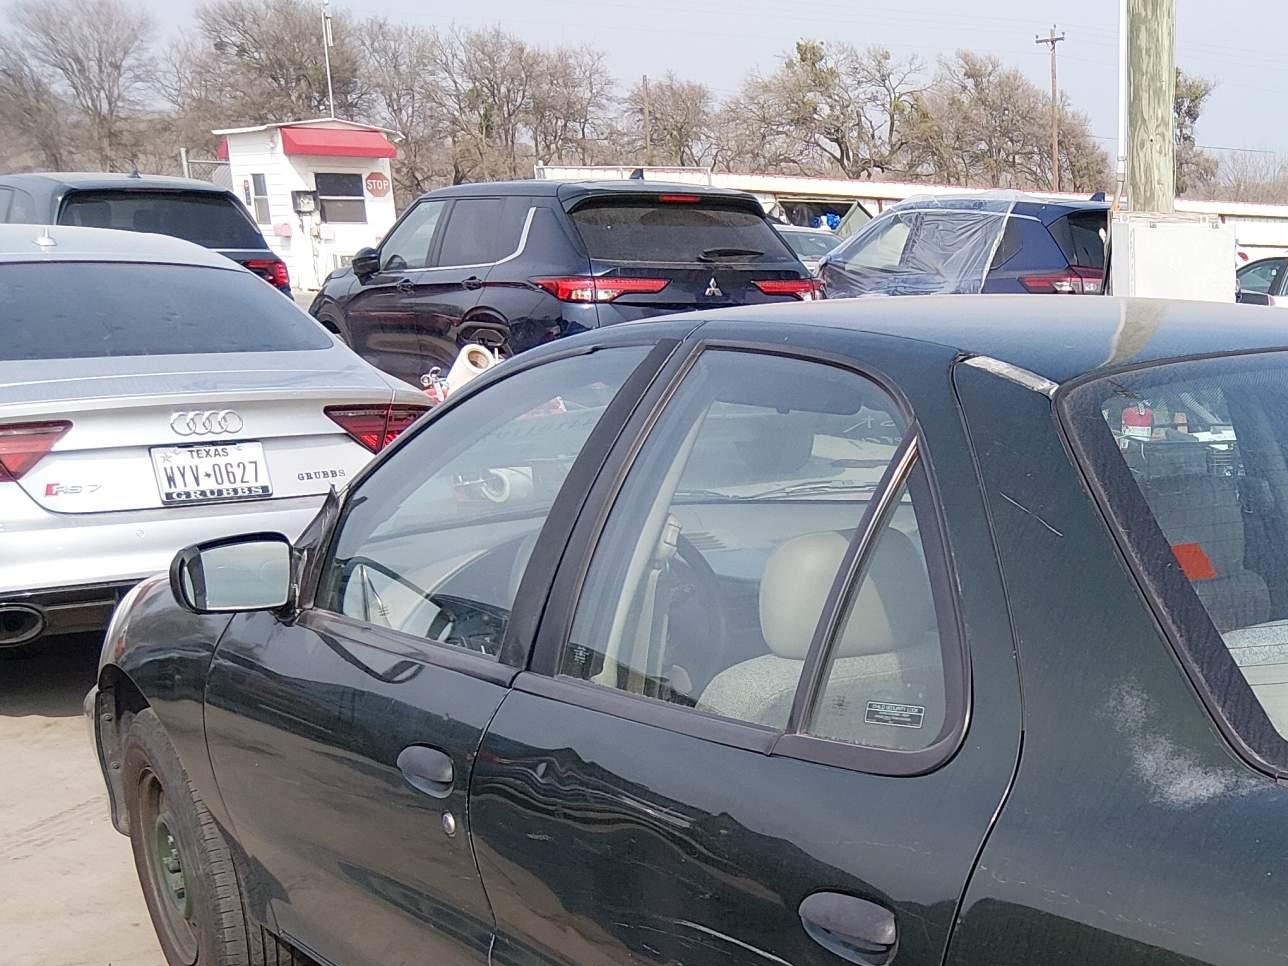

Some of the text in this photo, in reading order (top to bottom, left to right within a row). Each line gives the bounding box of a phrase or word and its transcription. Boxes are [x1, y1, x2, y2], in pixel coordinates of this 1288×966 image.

[367, 179, 389, 190] STOP
[188, 447, 229, 459] TEXAS
[297, 469, 346, 481] GRUBBS
[172, 486, 263, 500] GRUBBS
